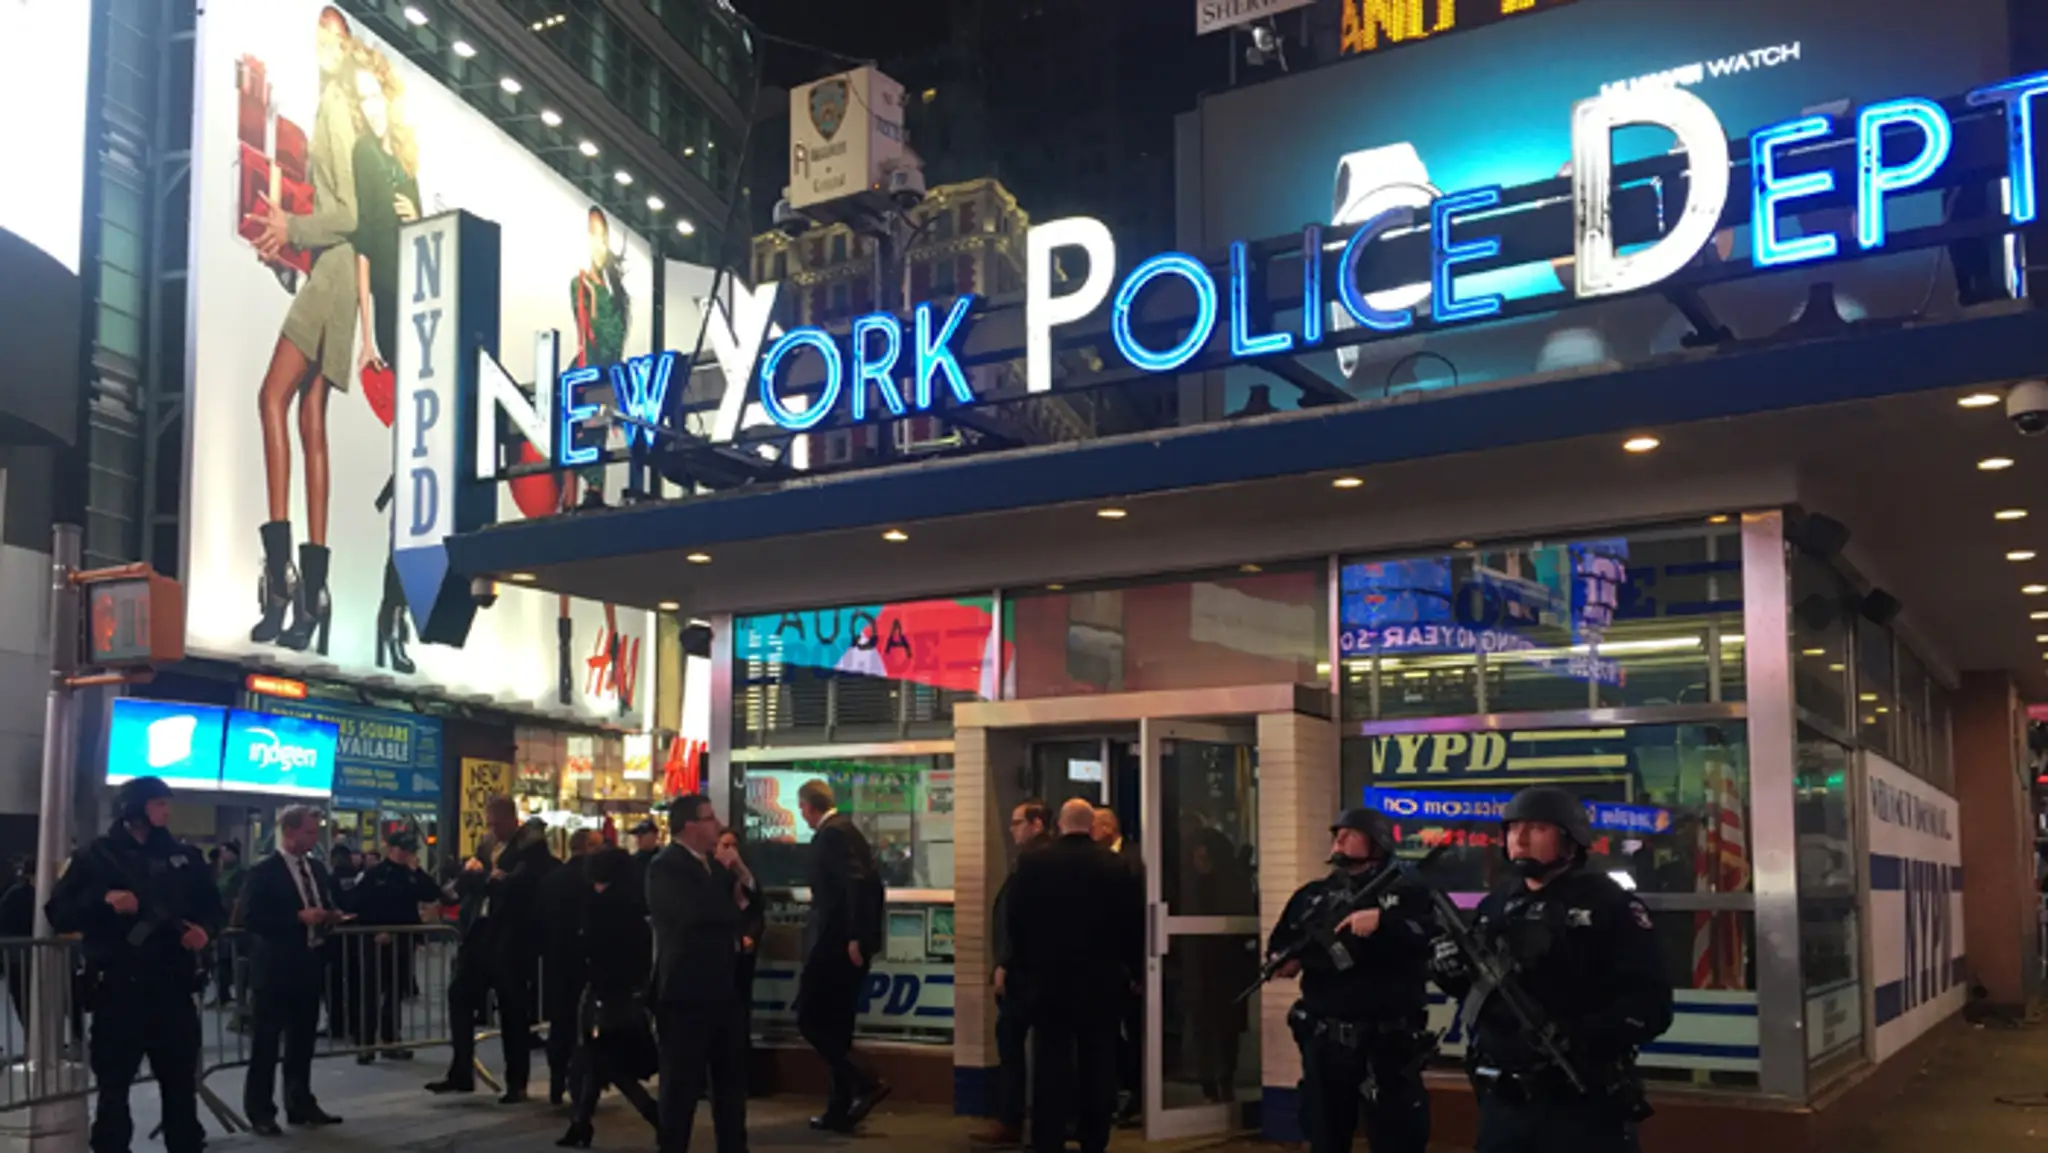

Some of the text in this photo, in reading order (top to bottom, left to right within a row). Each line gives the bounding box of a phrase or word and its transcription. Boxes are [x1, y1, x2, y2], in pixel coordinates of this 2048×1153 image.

[1706, 41, 1801, 78] WATCH
[476, 70, 2048, 480] NEW YORK POLICE DEPT
[410, 231, 444, 537] NYPD
[337, 737, 409, 763] VAILABLE
[1372, 731, 1508, 774] NYPD
[856, 972, 921, 1016] PD
